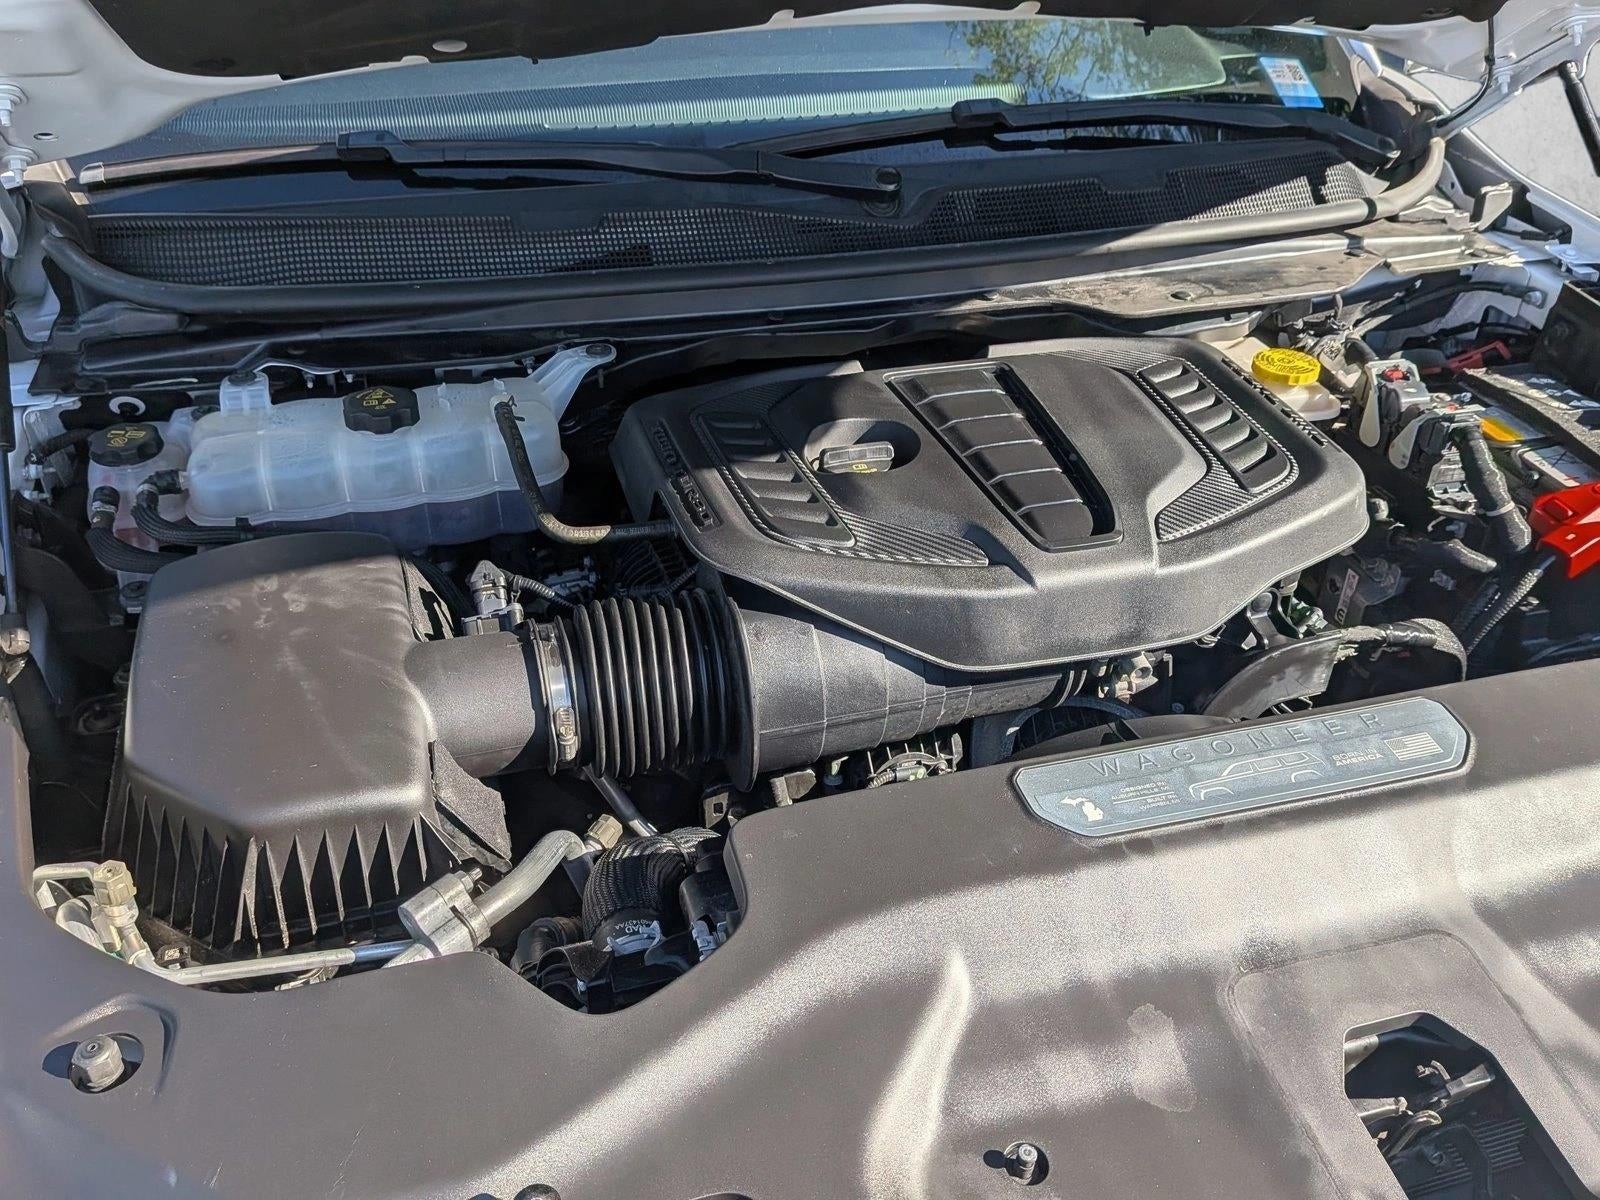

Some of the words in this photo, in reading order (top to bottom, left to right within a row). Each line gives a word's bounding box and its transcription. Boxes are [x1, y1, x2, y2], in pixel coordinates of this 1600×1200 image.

[1087, 713, 1384, 777] WAGONEER
[1332, 750, 1363, 761] BORN
[1336, 752, 1384, 766] AMERICA
